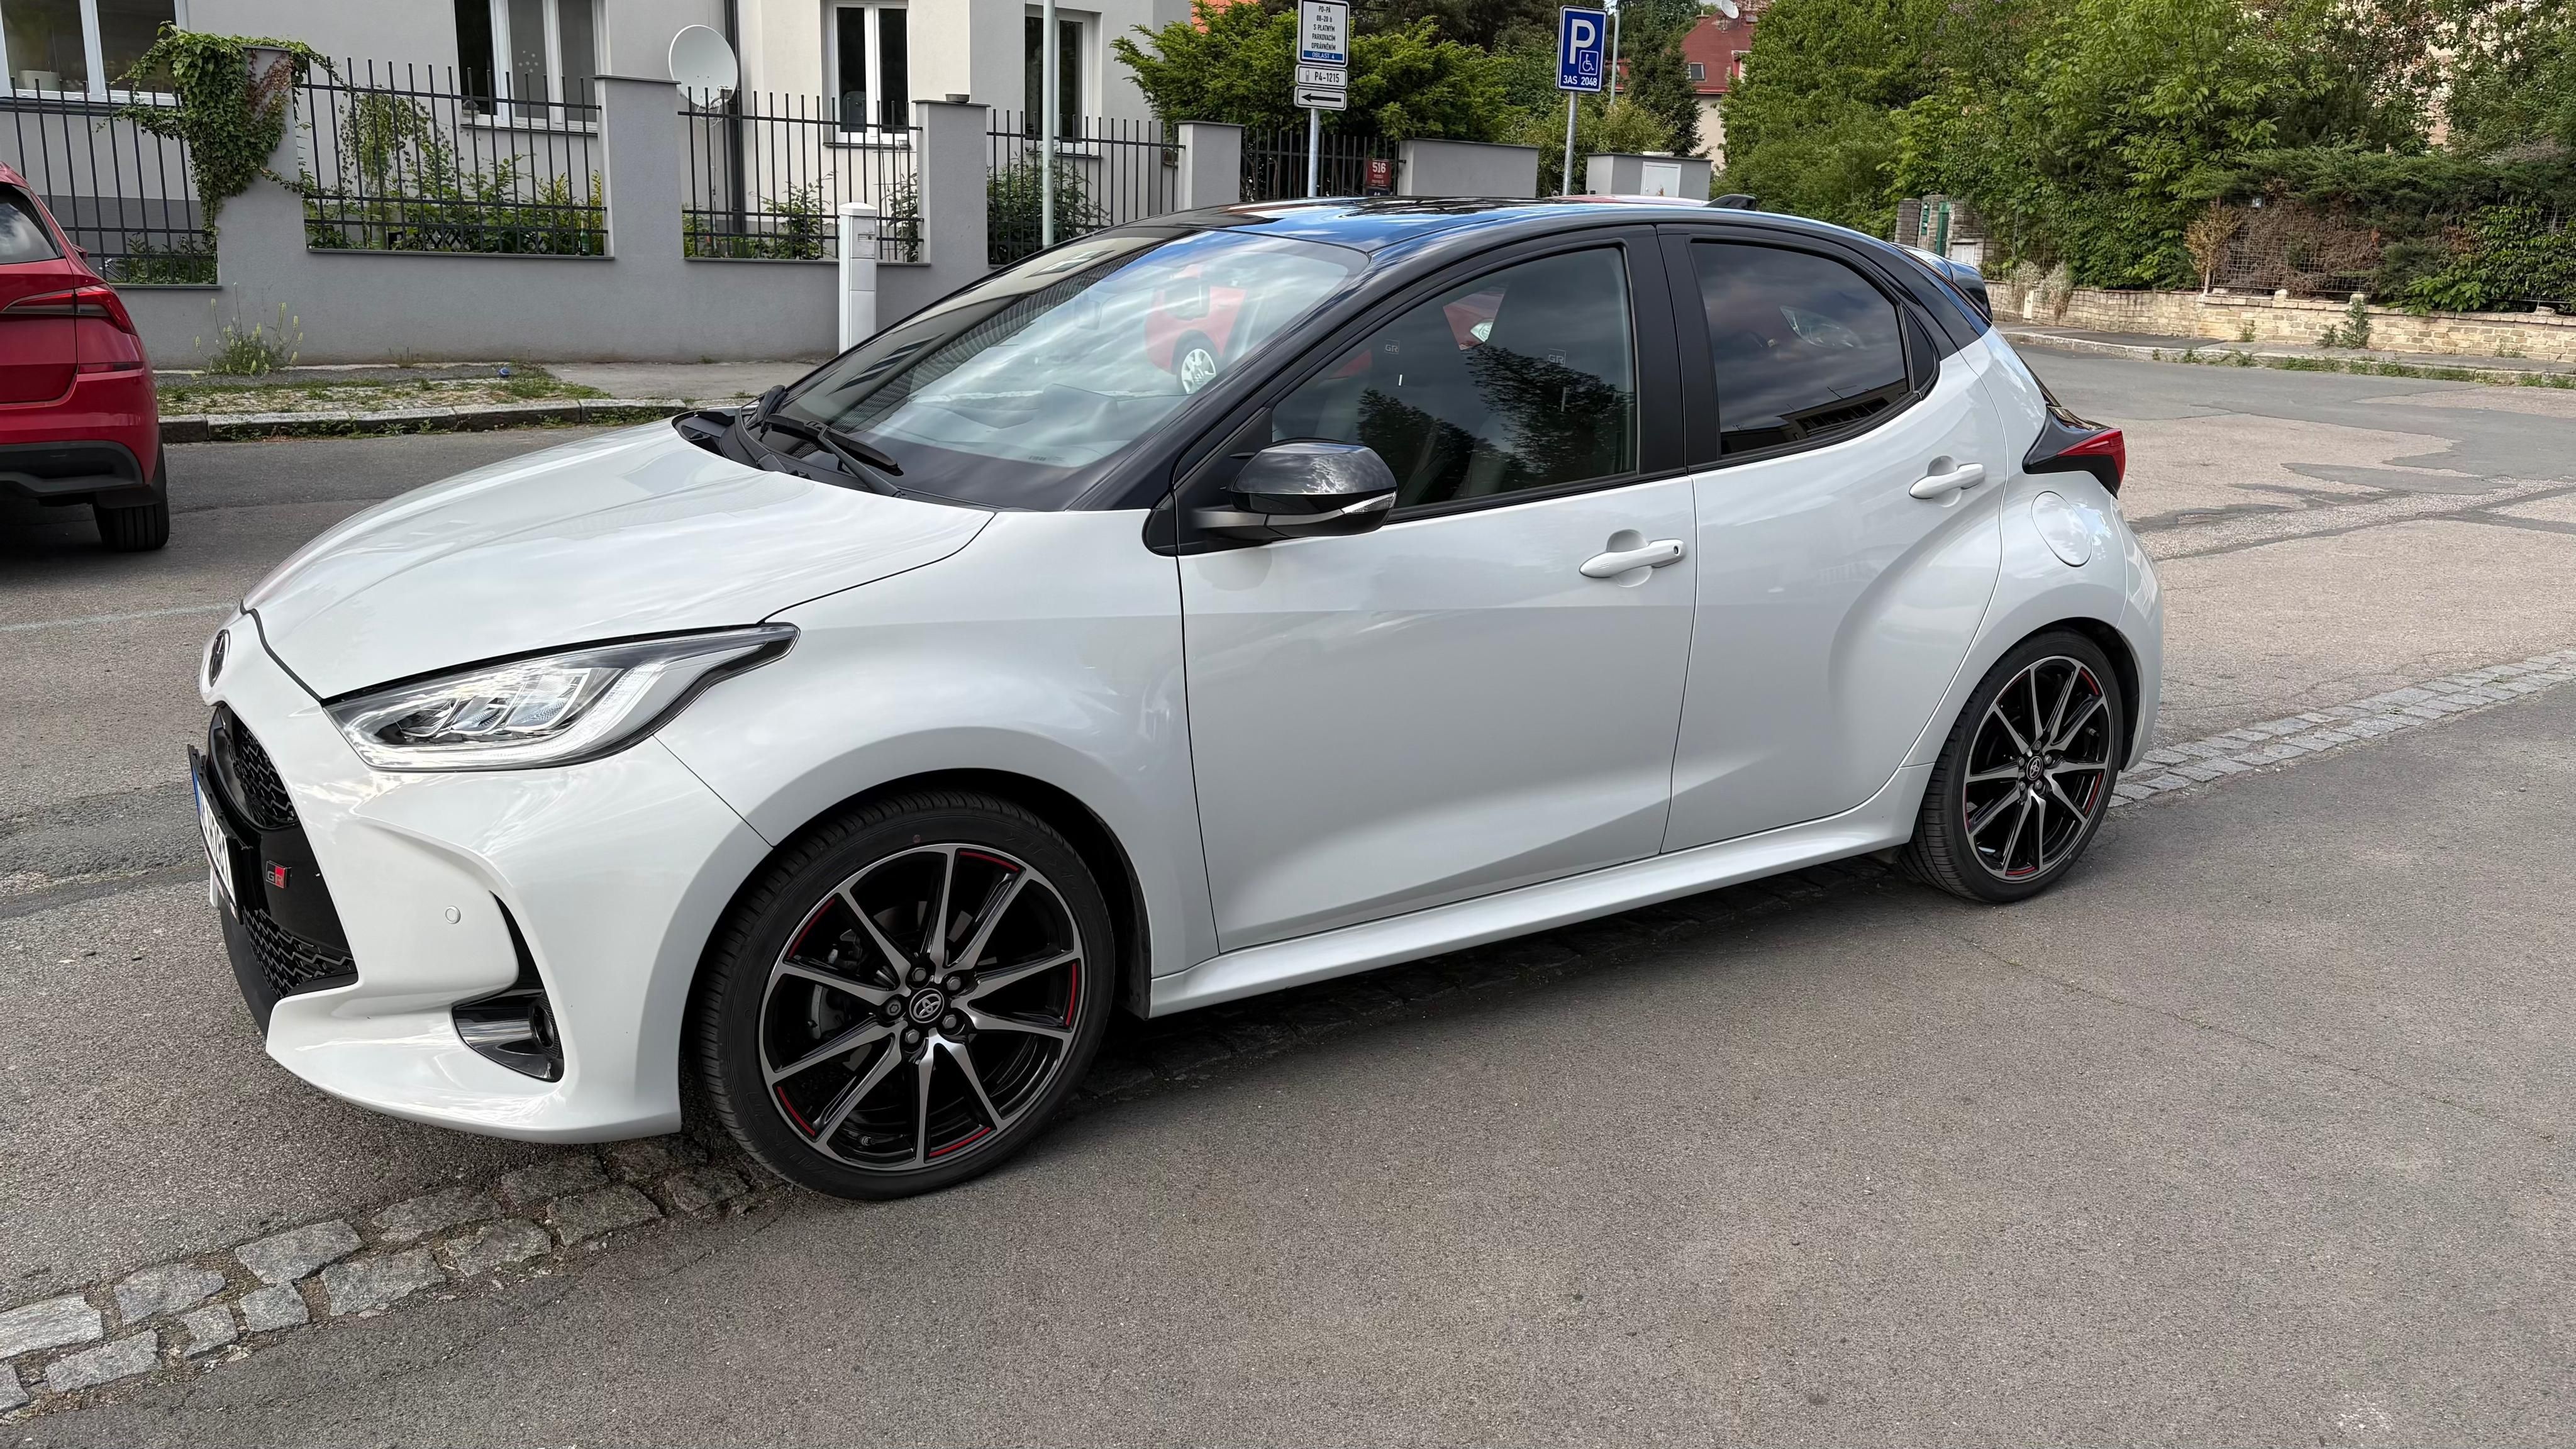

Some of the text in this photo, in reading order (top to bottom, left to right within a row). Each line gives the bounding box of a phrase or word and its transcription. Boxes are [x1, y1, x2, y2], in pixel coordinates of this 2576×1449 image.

[1569, 18, 1596, 65] P
[1314, 71, 1340, 83] P4-1215
[1563, 75, 1597, 86] 3AS 2048
[1372, 162, 1386, 173] 516
[1385, 344, 1399, 353] GR
[1548, 354, 1564, 364] GR
[267, 870, 284, 887] GR
